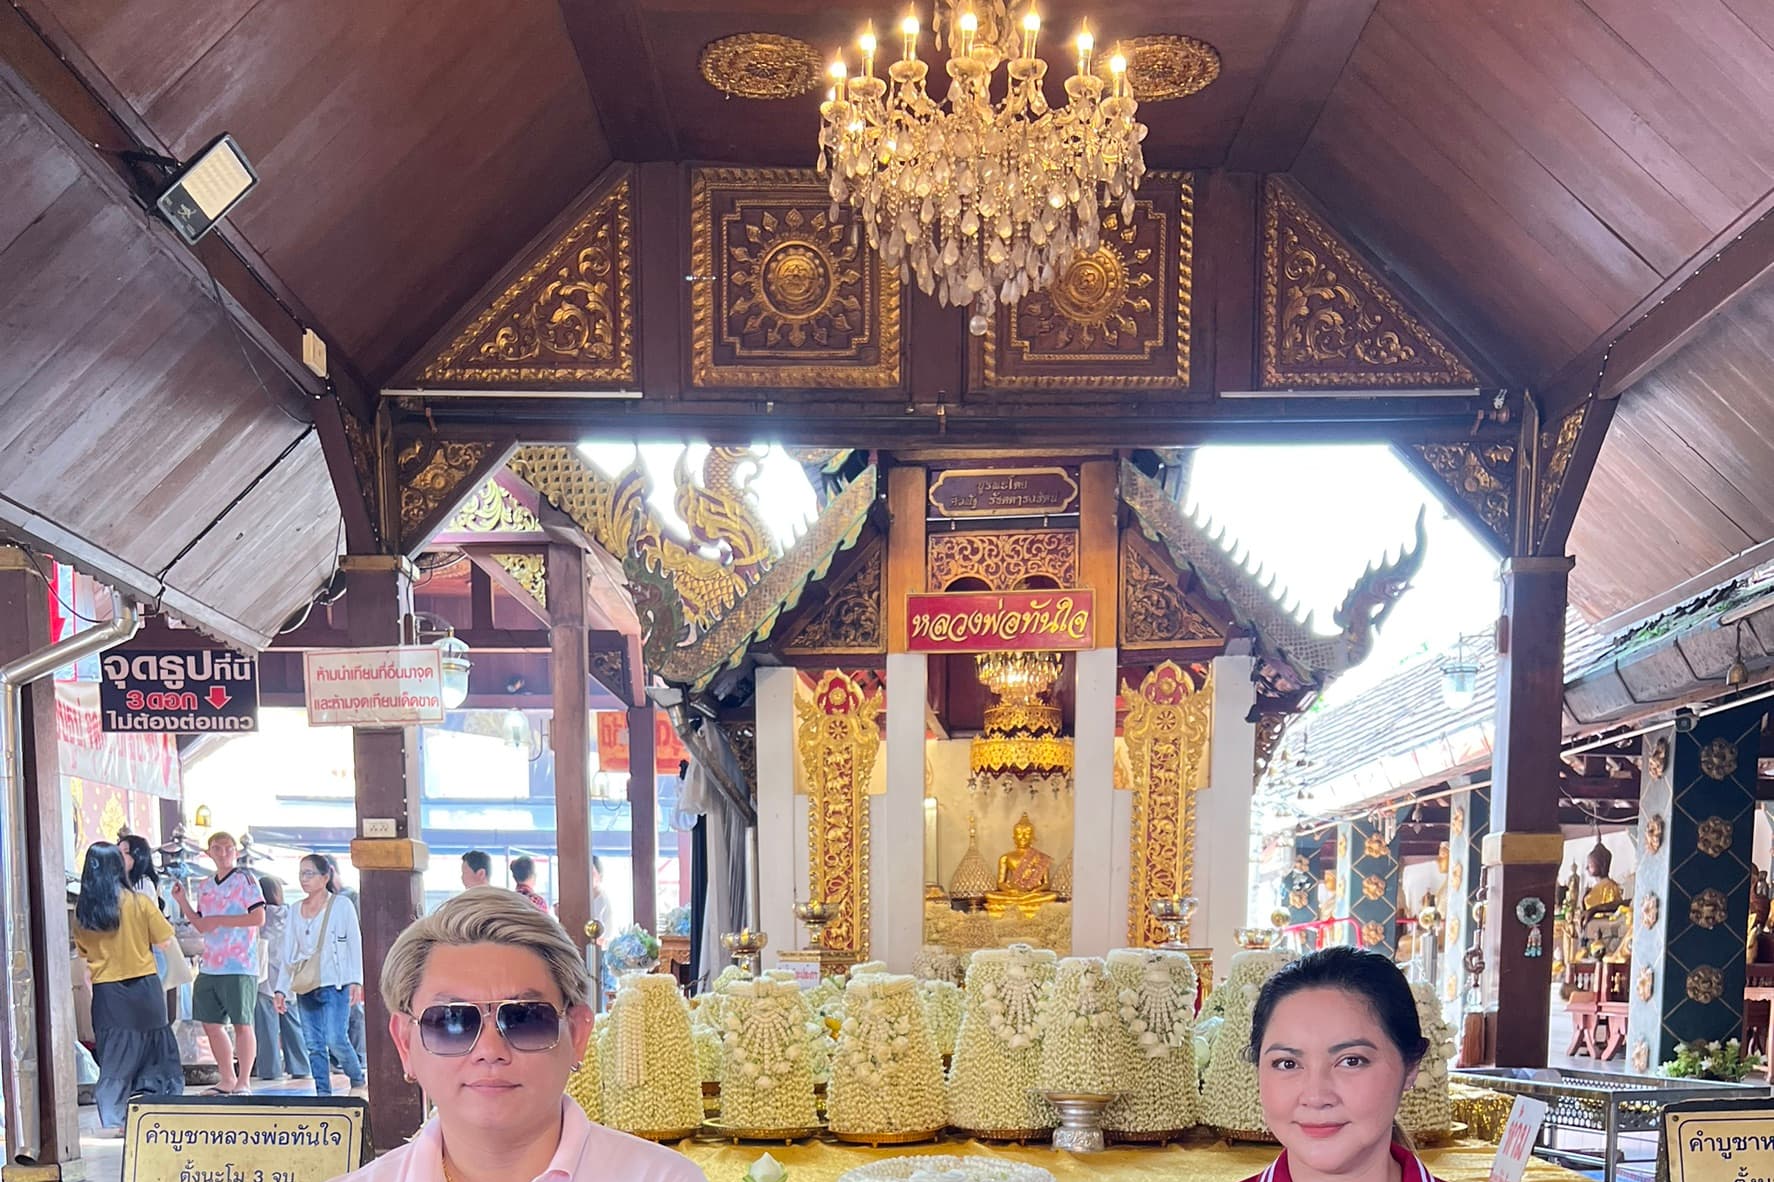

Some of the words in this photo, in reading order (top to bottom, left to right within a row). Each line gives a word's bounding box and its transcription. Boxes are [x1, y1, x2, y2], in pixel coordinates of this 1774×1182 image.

[911, 596, 1089, 642] หลวงพ่อทันใจ
[103, 649, 251, 690] จุดธูปที่นี
[316, 661, 434, 683] ห้ามนำเทียนที่อื่นมาจุด
[314, 691, 440, 713] และห้ามจุดเทียนเด็ดขาด
[106, 710, 255, 731] ไม่ต้องต่อแถว
[145, 1122, 342, 1152] คำบูชาหลวงพ่อทันใจ
